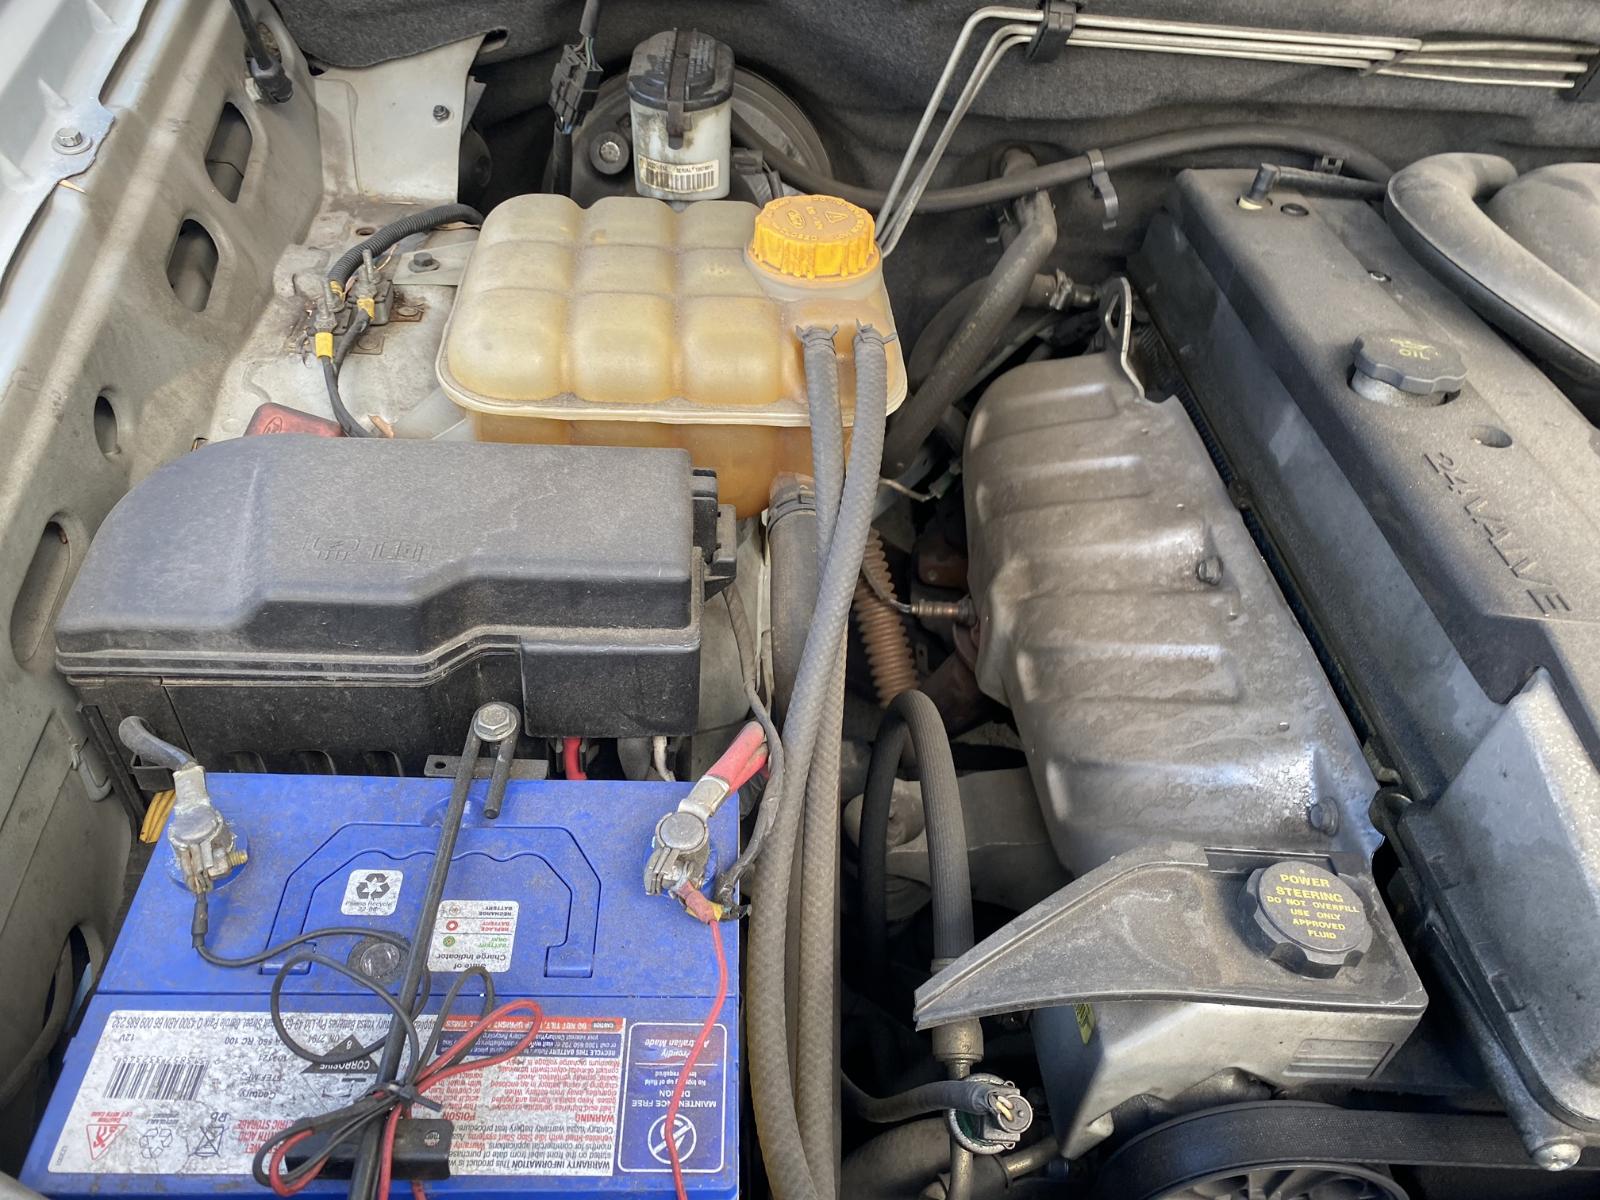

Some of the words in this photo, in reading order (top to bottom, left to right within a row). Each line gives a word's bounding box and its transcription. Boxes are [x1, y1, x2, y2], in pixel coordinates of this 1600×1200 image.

[1399, 349, 1430, 361] OIL
[1280, 874, 1330, 888] POWER
[1276, 886, 1344, 903] STEERING
[1266, 896, 1281, 904] DO
[1286, 898, 1306, 907] NOT
[1312, 902, 1360, 913] OVERFILL
[1290, 908, 1309, 917] USE
[1317, 912, 1340, 920] ONLY
[1293, 919, 1345, 931] APPROVED
[1308, 930, 1336, 940] FLUID
[476, 953, 506, 961] Charge
[119, 1033, 135, 1042] 12V
[224, 1037, 239, 1046] 100
[241, 1037, 254, 1046] RC
[645, 1039, 667, 1048] Made
[240, 1089, 276, 1100] Century
[632, 1099, 654, 1107] FREE
[656, 1099, 717, 1108] MAINTENCE
[442, 1111, 476, 1121] POISON
[576, 1114, 614, 1123] WARNING
[238, 1119, 270, 1130] STORAGE
[498, 1133, 515, 1142] Start
[492, 1151, 508, 1159] date
[510, 1151, 527, 1160] from
[528, 1151, 545, 1160] label
[546, 1151, 563, 1160] front
[565, 1151, 577, 1160] the
[458, 1160, 464, 1168] is
[466, 1158, 494, 1168] product
[496, 1160, 510, 1168] This
[512, 1160, 564, 1169] INFORMATION
[566, 1160, 610, 1169] WARRANTY
